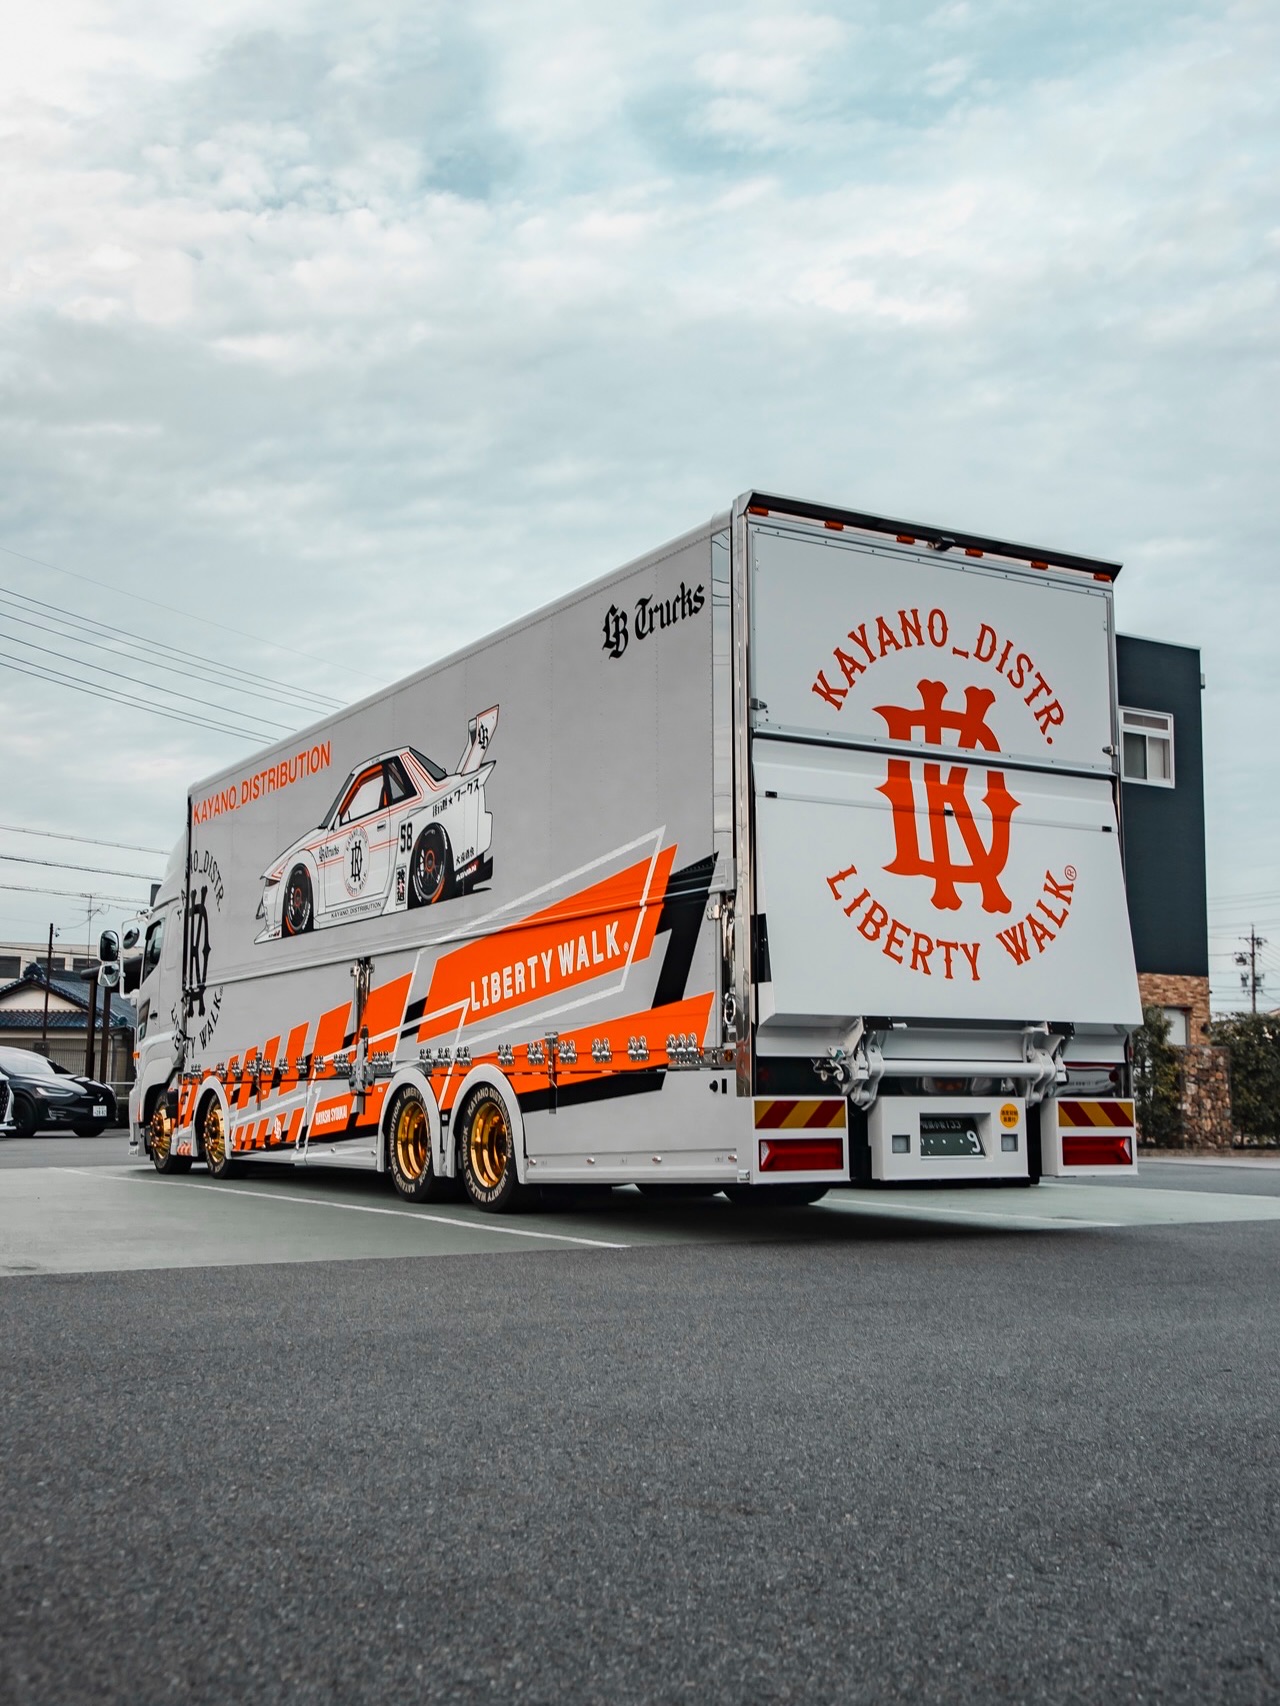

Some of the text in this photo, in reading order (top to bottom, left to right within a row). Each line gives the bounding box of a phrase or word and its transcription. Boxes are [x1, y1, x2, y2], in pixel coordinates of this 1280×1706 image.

[635, 581, 705, 640] Trucks
[193, 740, 331, 826] KAYANO_DISTRIBUTION
[400, 822, 413, 853] 58
[826, 864, 980, 981] LIBERTY
[470, 949, 553, 1012] LIBERTY
